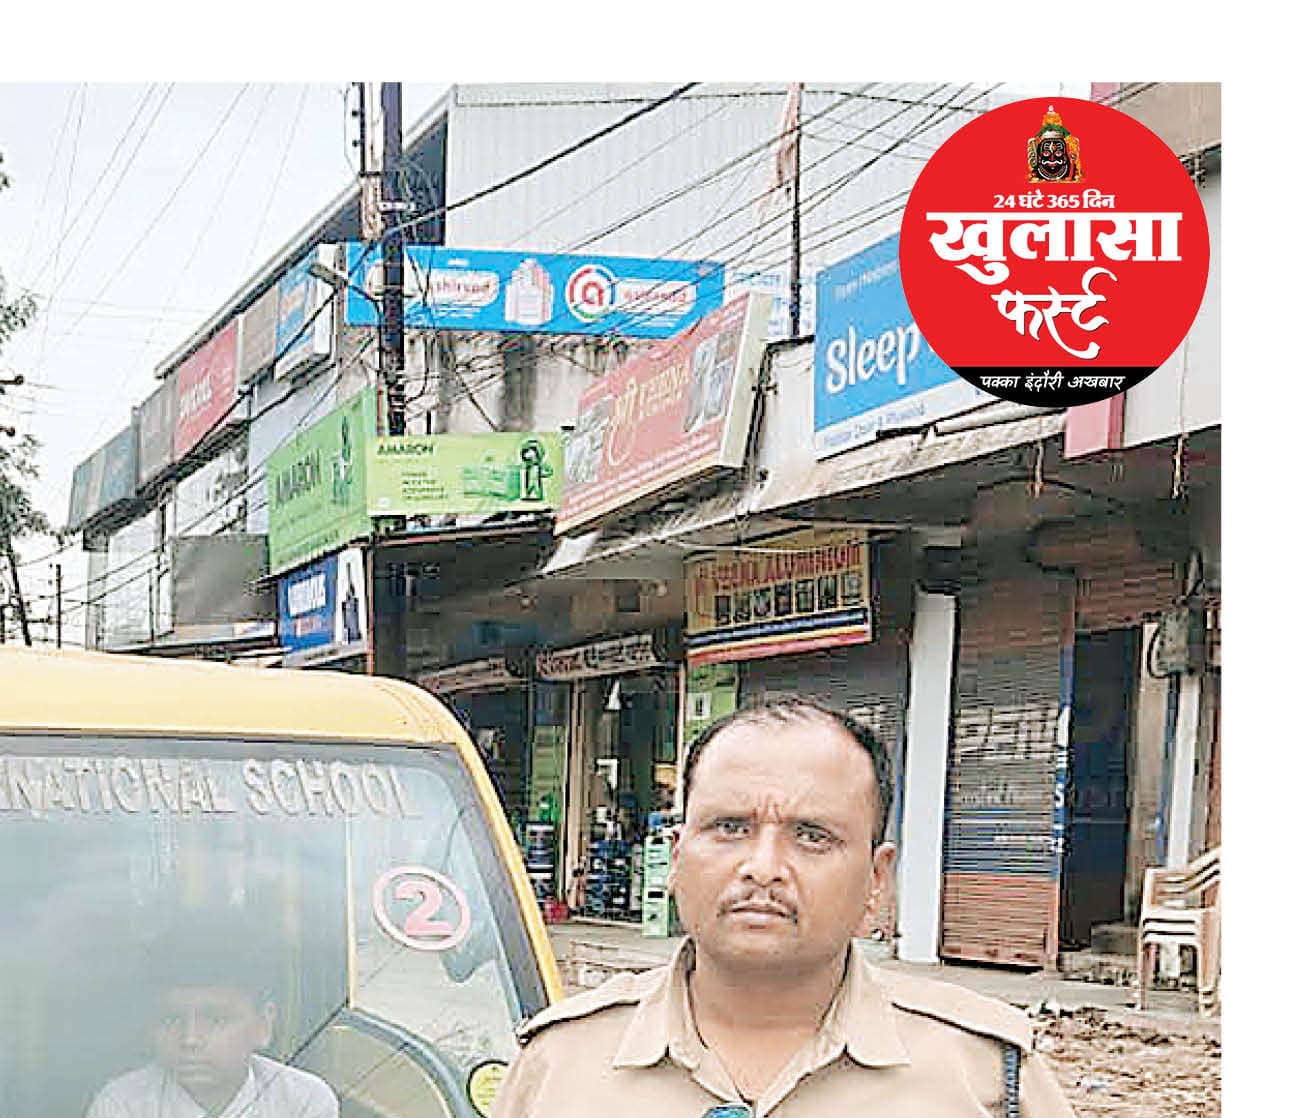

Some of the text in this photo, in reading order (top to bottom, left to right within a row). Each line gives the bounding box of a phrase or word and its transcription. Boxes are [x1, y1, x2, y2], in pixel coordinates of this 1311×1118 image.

[825, 324, 922, 393] Sleep
[242, 759, 424, 819] SCHOOL
[394, 880, 453, 936] 2
